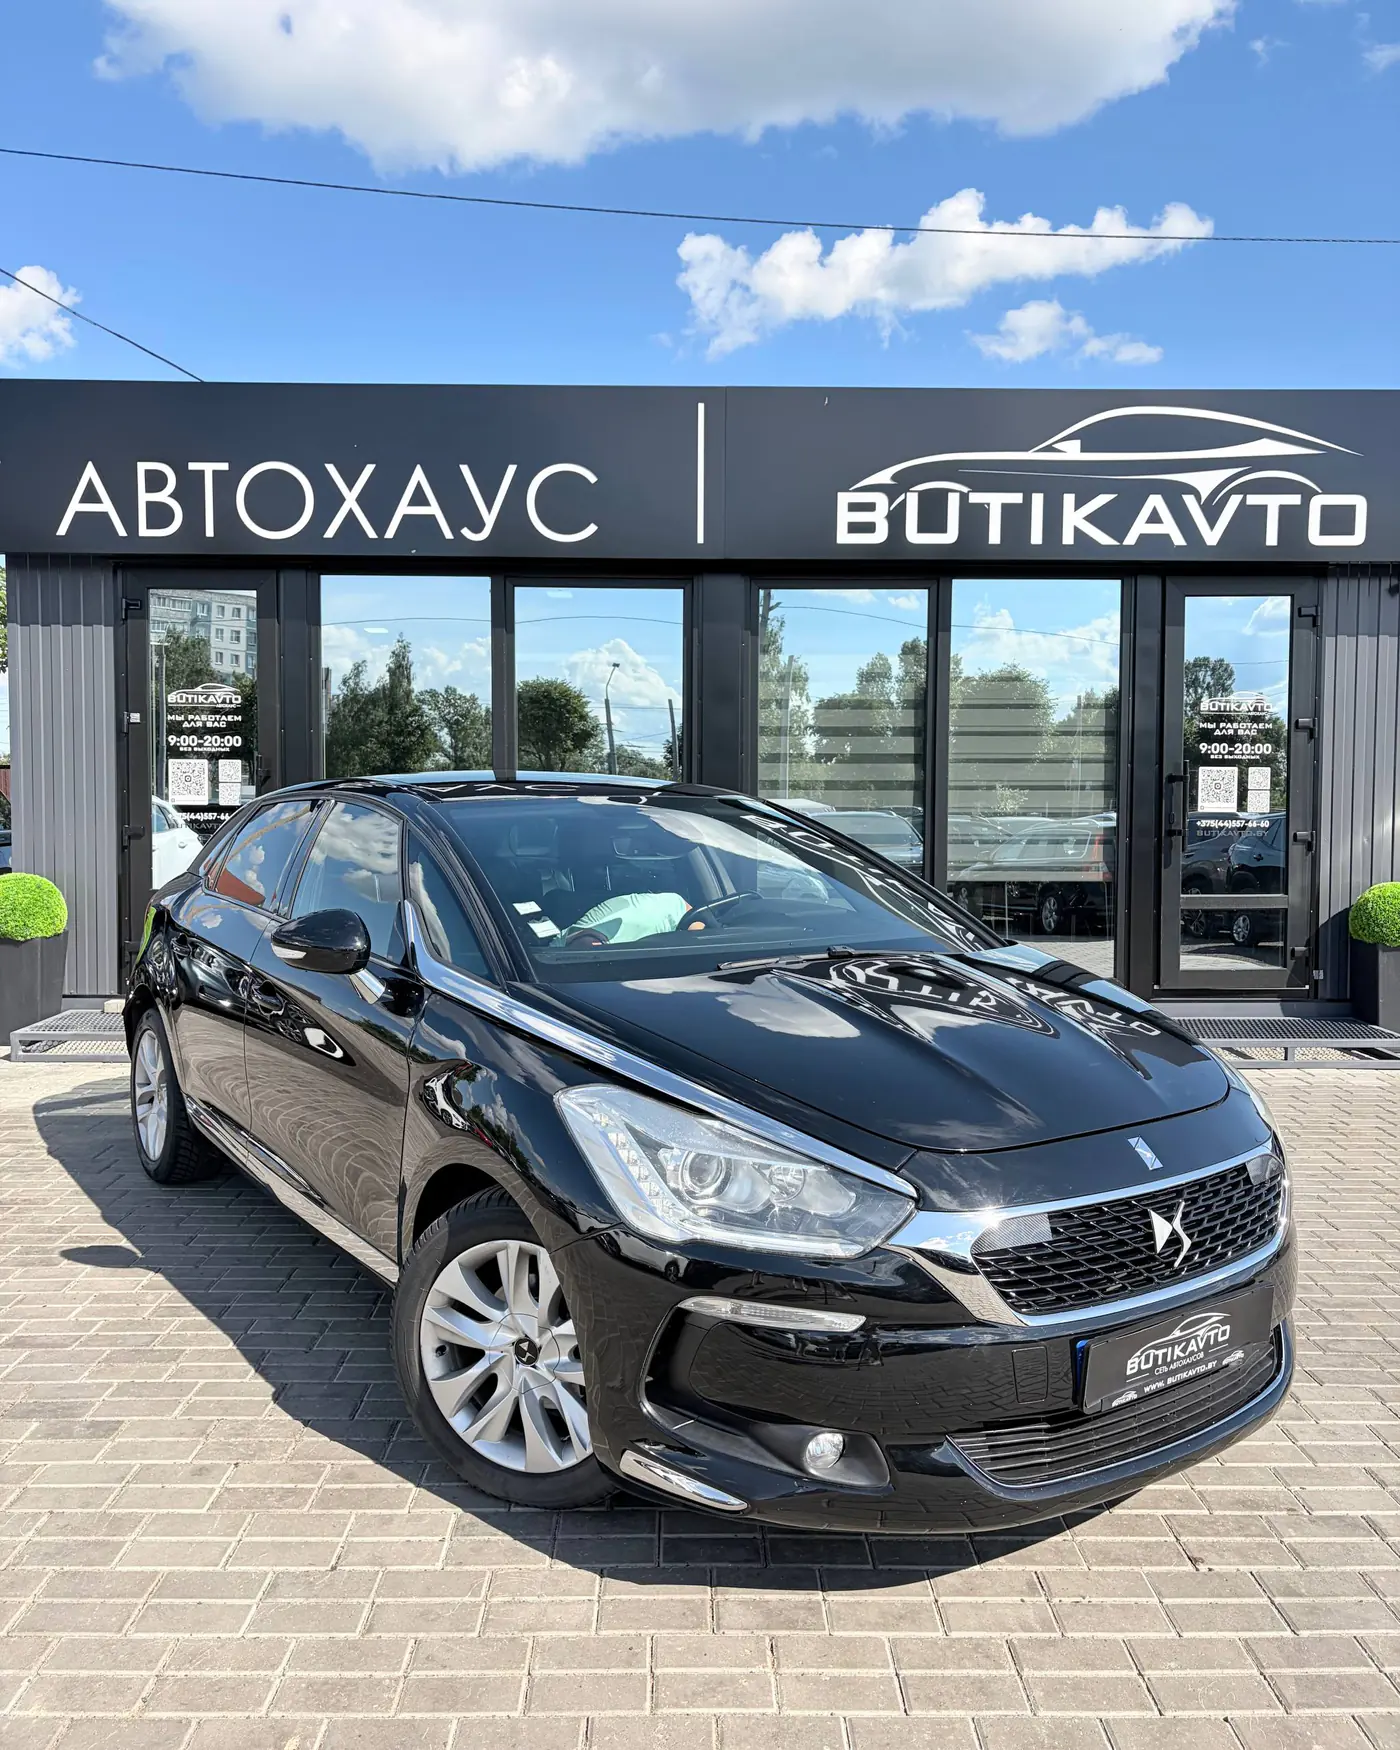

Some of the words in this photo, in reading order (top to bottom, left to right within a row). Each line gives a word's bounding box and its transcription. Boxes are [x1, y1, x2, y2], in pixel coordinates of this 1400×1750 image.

[56, 461, 599, 543] АВТОХАУС
[836, 491, 1368, 547] BUTIKAVTO
[167, 694, 242, 703] BUTIKAVTO
[1200, 701, 1272, 711] BUTIKAVTO
[167, 735, 242, 747] 9:00-20:00
[1199, 743, 1272, 755] 9:00-20:00
[1196, 819, 1270, 829] +375(44)557-66-60
[1126, 1324, 1231, 1376] BUTIKAVTO
[1169, 1351, 1204, 1370] АВТОХАУСОВ
[1166, 1360, 1218, 1385] BUTIKAVTO.BY
